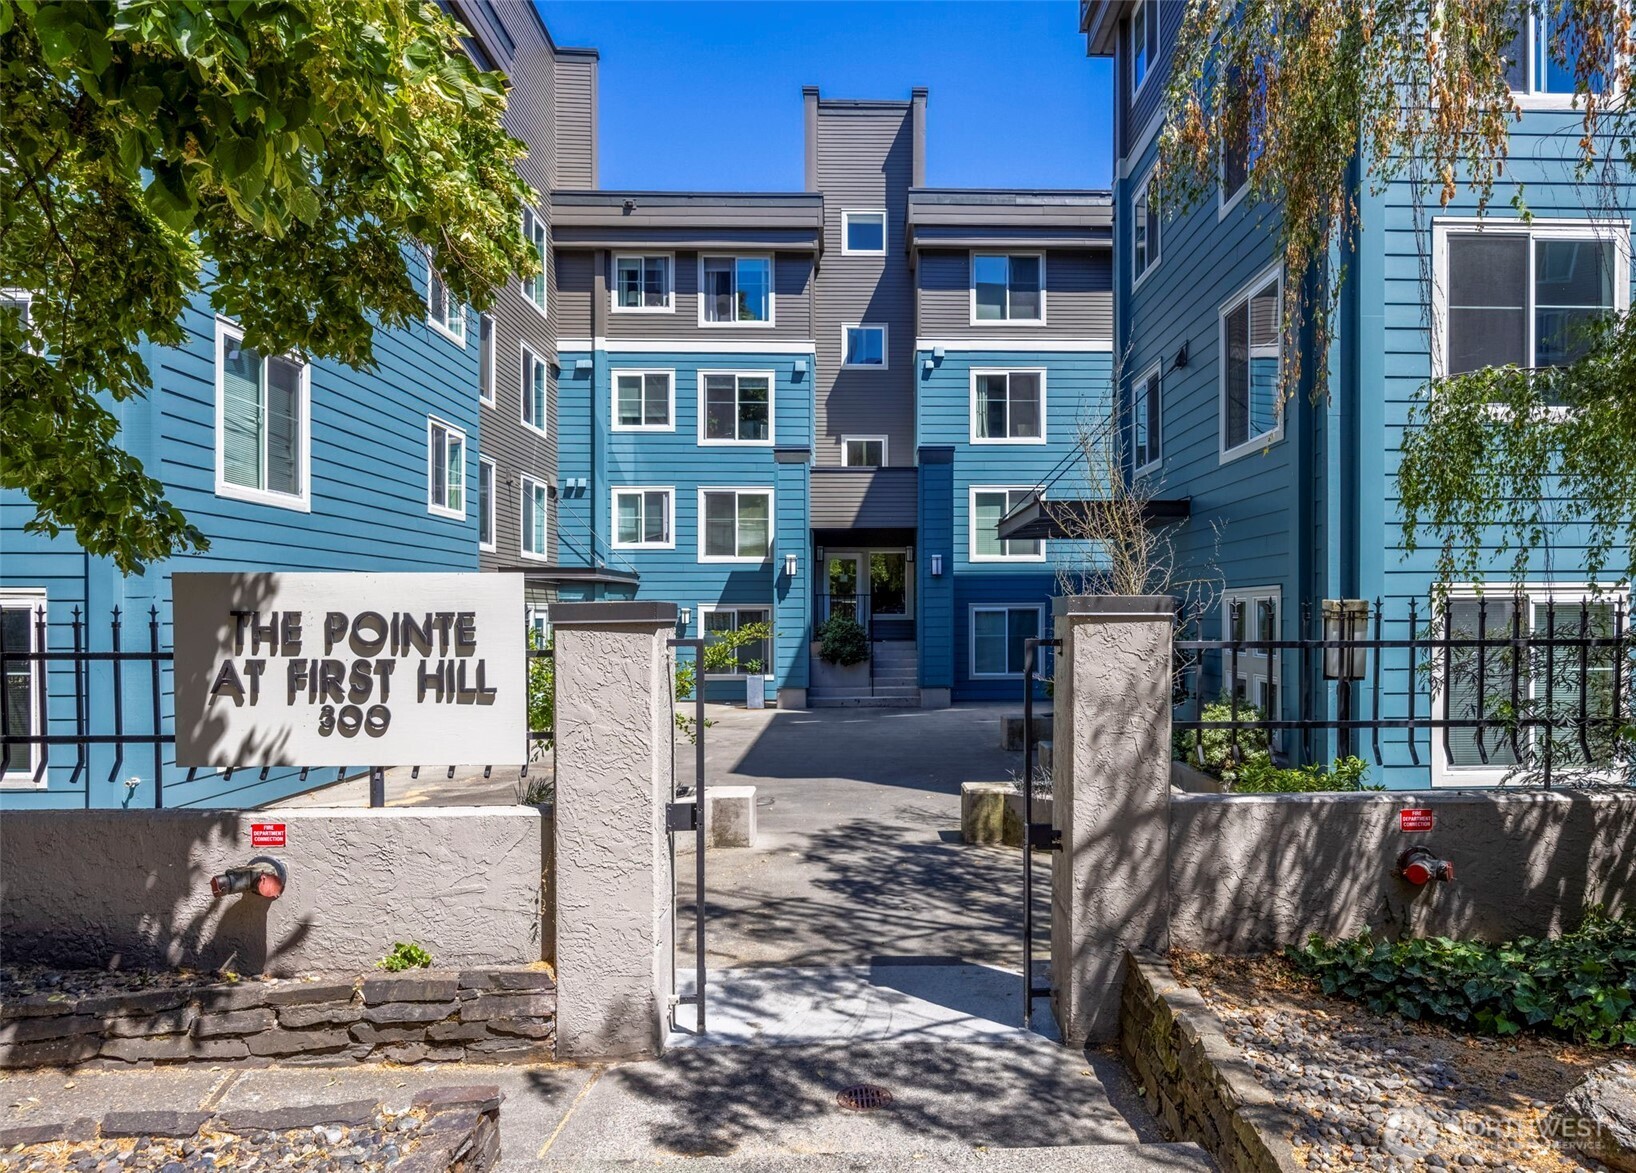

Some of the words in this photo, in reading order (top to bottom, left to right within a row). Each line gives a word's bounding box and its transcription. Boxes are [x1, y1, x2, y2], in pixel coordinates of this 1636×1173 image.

[230, 611, 302, 646] THE
[325, 611, 477, 647] POINTE
[209, 659, 267, 694] AT
[287, 658, 396, 694] FIRST
[418, 659, 498, 694] HILL
[319, 704, 391, 728] 300
